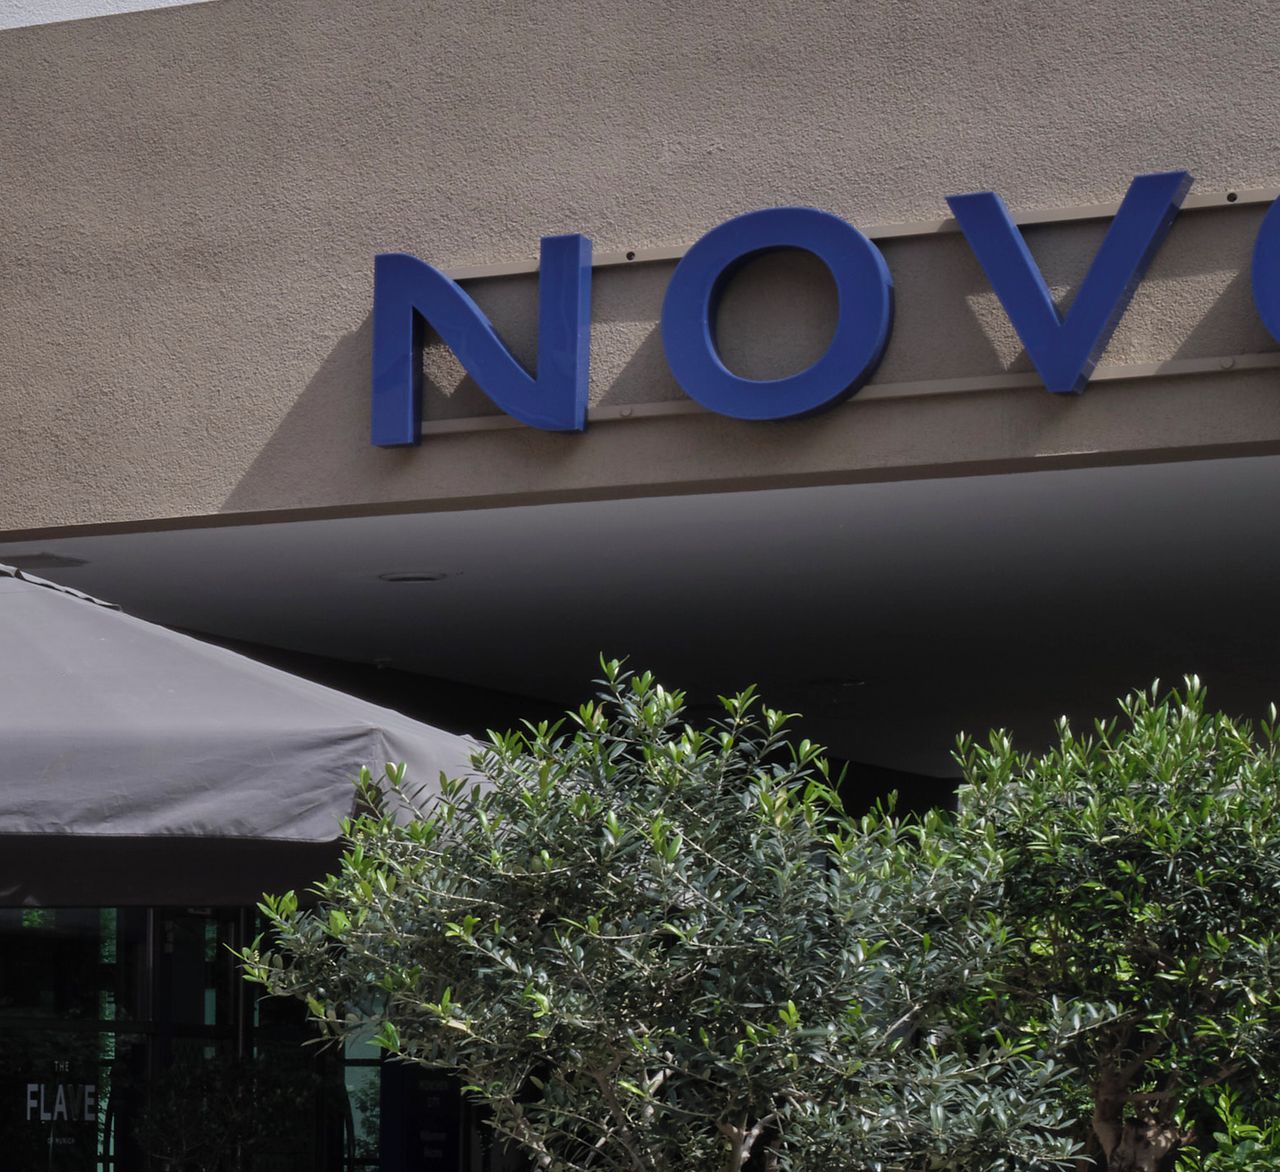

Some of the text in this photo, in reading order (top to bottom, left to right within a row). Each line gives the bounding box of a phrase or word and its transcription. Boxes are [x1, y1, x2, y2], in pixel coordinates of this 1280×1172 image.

[371, 170, 1280, 448] NOV
[54, 1061, 70, 1072] THE
[27, 1083, 96, 1121] FLAVE
